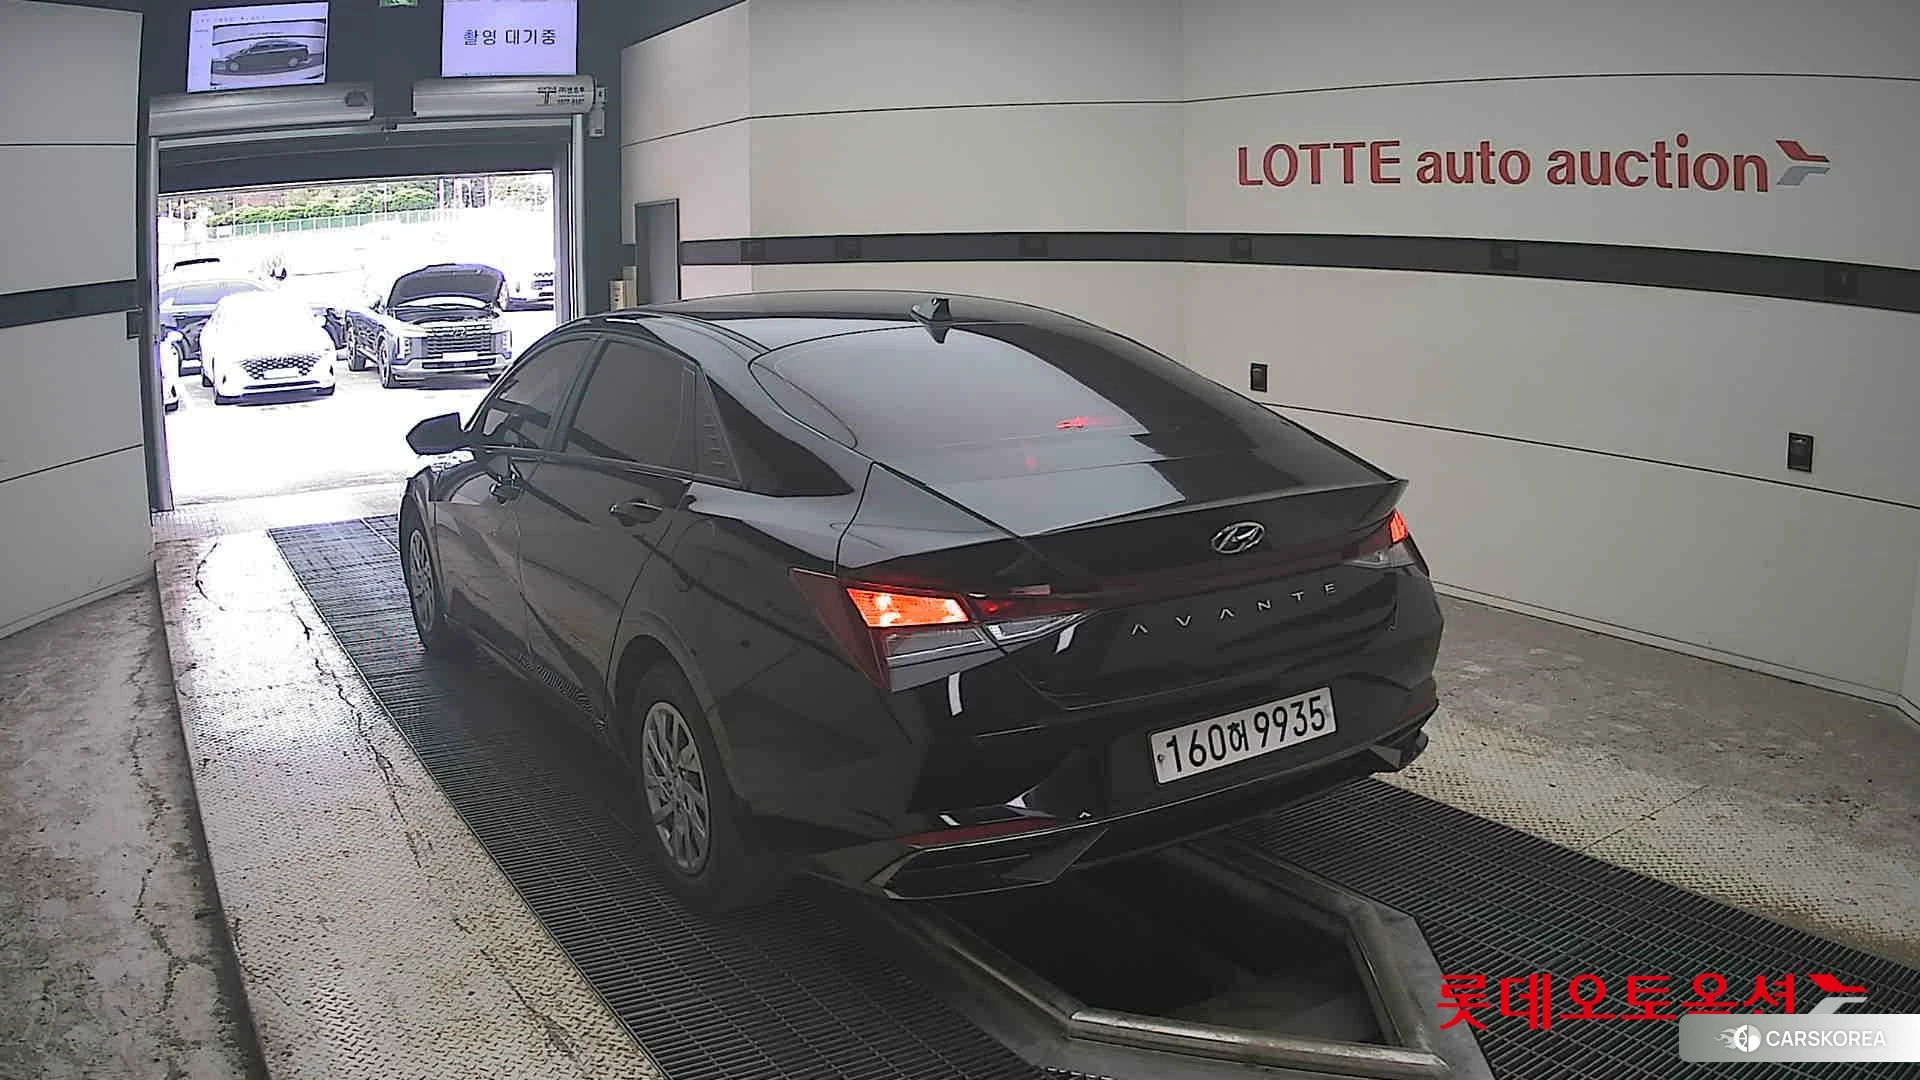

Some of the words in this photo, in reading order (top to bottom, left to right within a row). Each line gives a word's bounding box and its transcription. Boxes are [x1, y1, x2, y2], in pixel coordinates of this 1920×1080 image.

[463, 29, 497, 46] 촬영
[505, 29, 557, 46] 대기중
[1238, 141, 1400, 187] LOTTE
[1417, 141, 1531, 185] auto
[1546, 133, 1768, 193] auction
[1131, 583, 1336, 636] AVANTE
